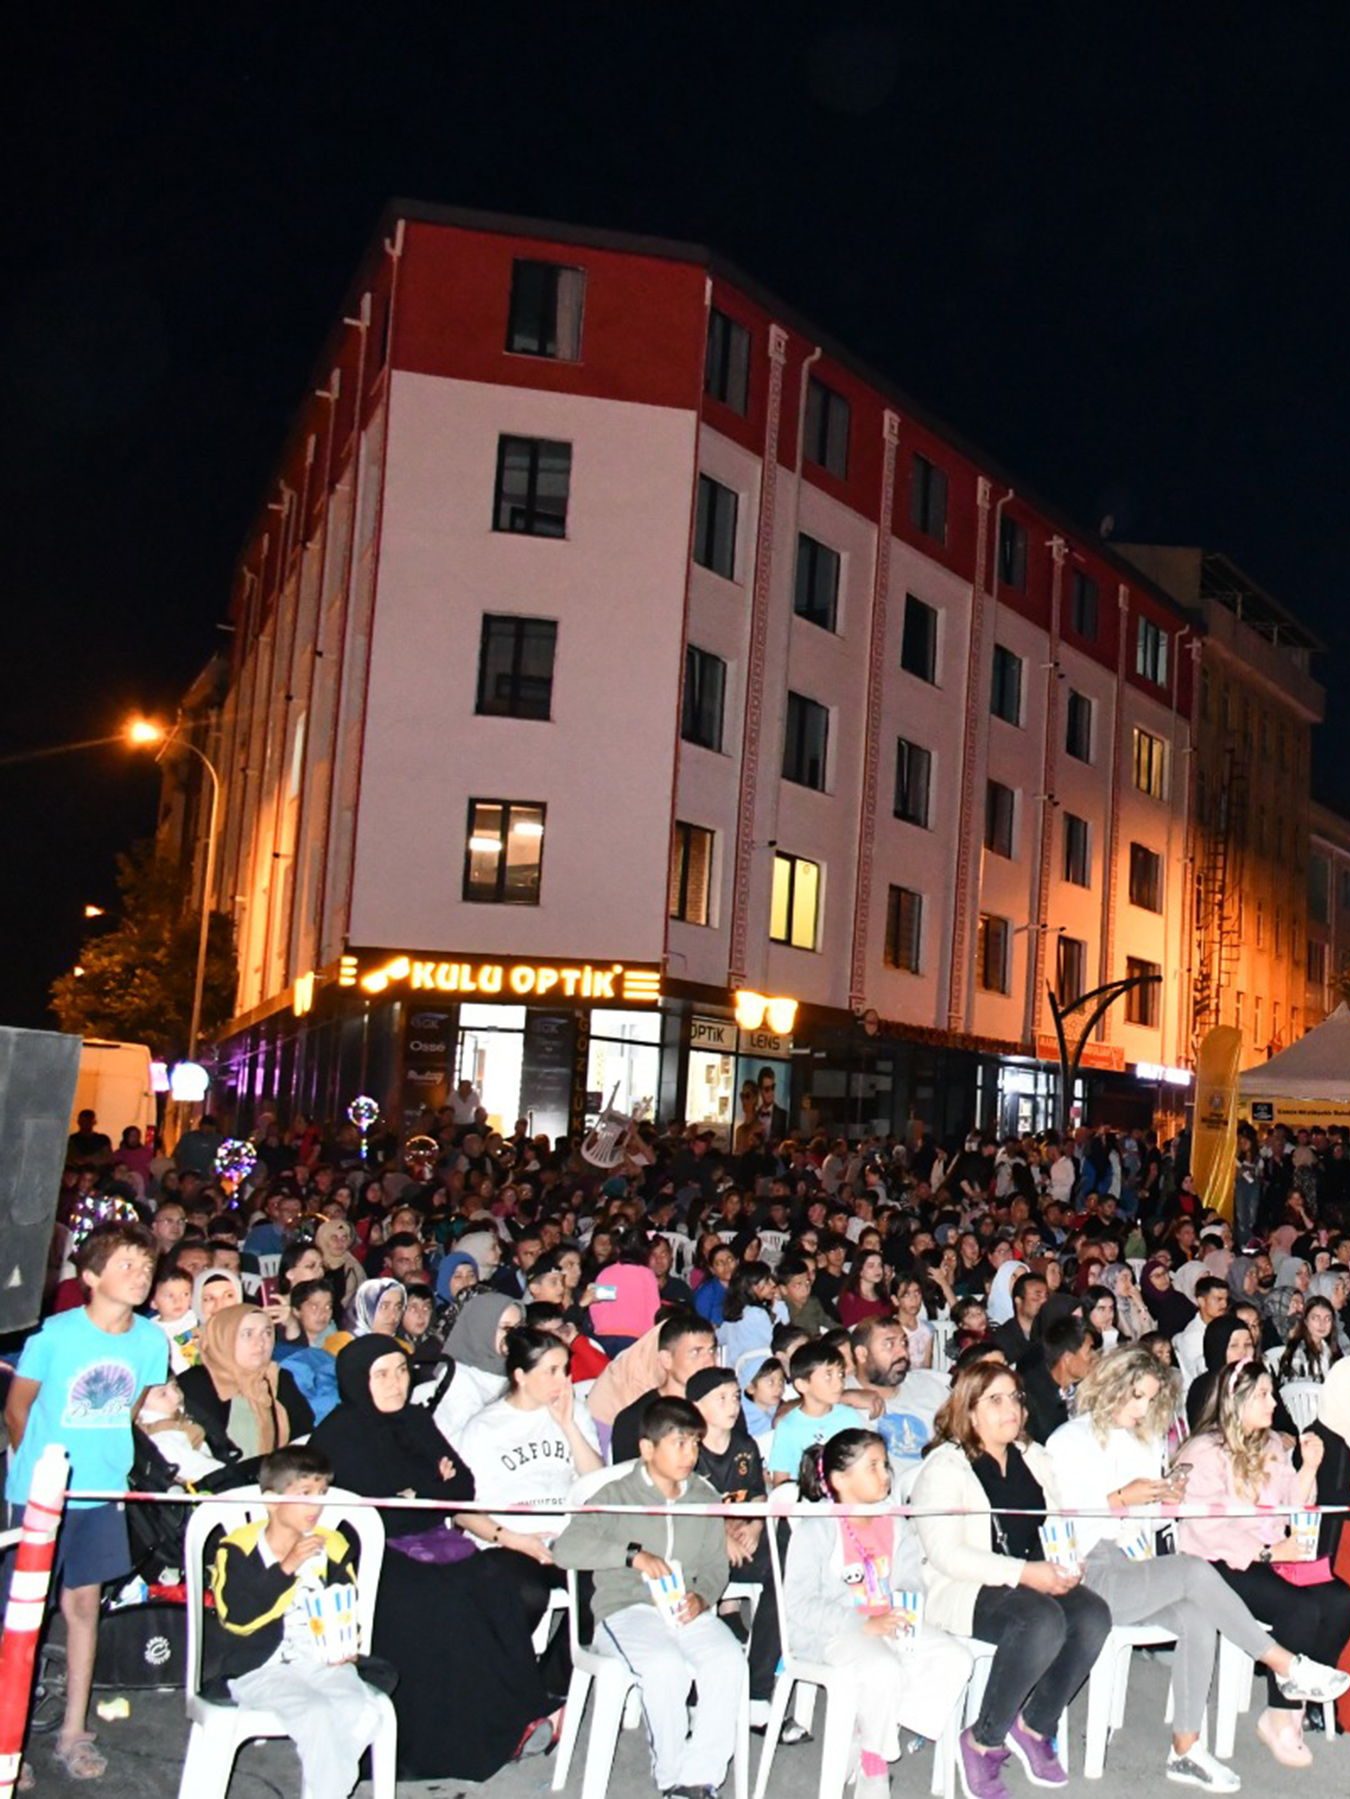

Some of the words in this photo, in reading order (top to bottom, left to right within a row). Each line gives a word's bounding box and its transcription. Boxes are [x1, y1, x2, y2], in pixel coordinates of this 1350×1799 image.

[411, 961, 503, 993] KULU
[750, 1033, 781, 1050] LENS
[501, 1440, 570, 1471] OXFOR
